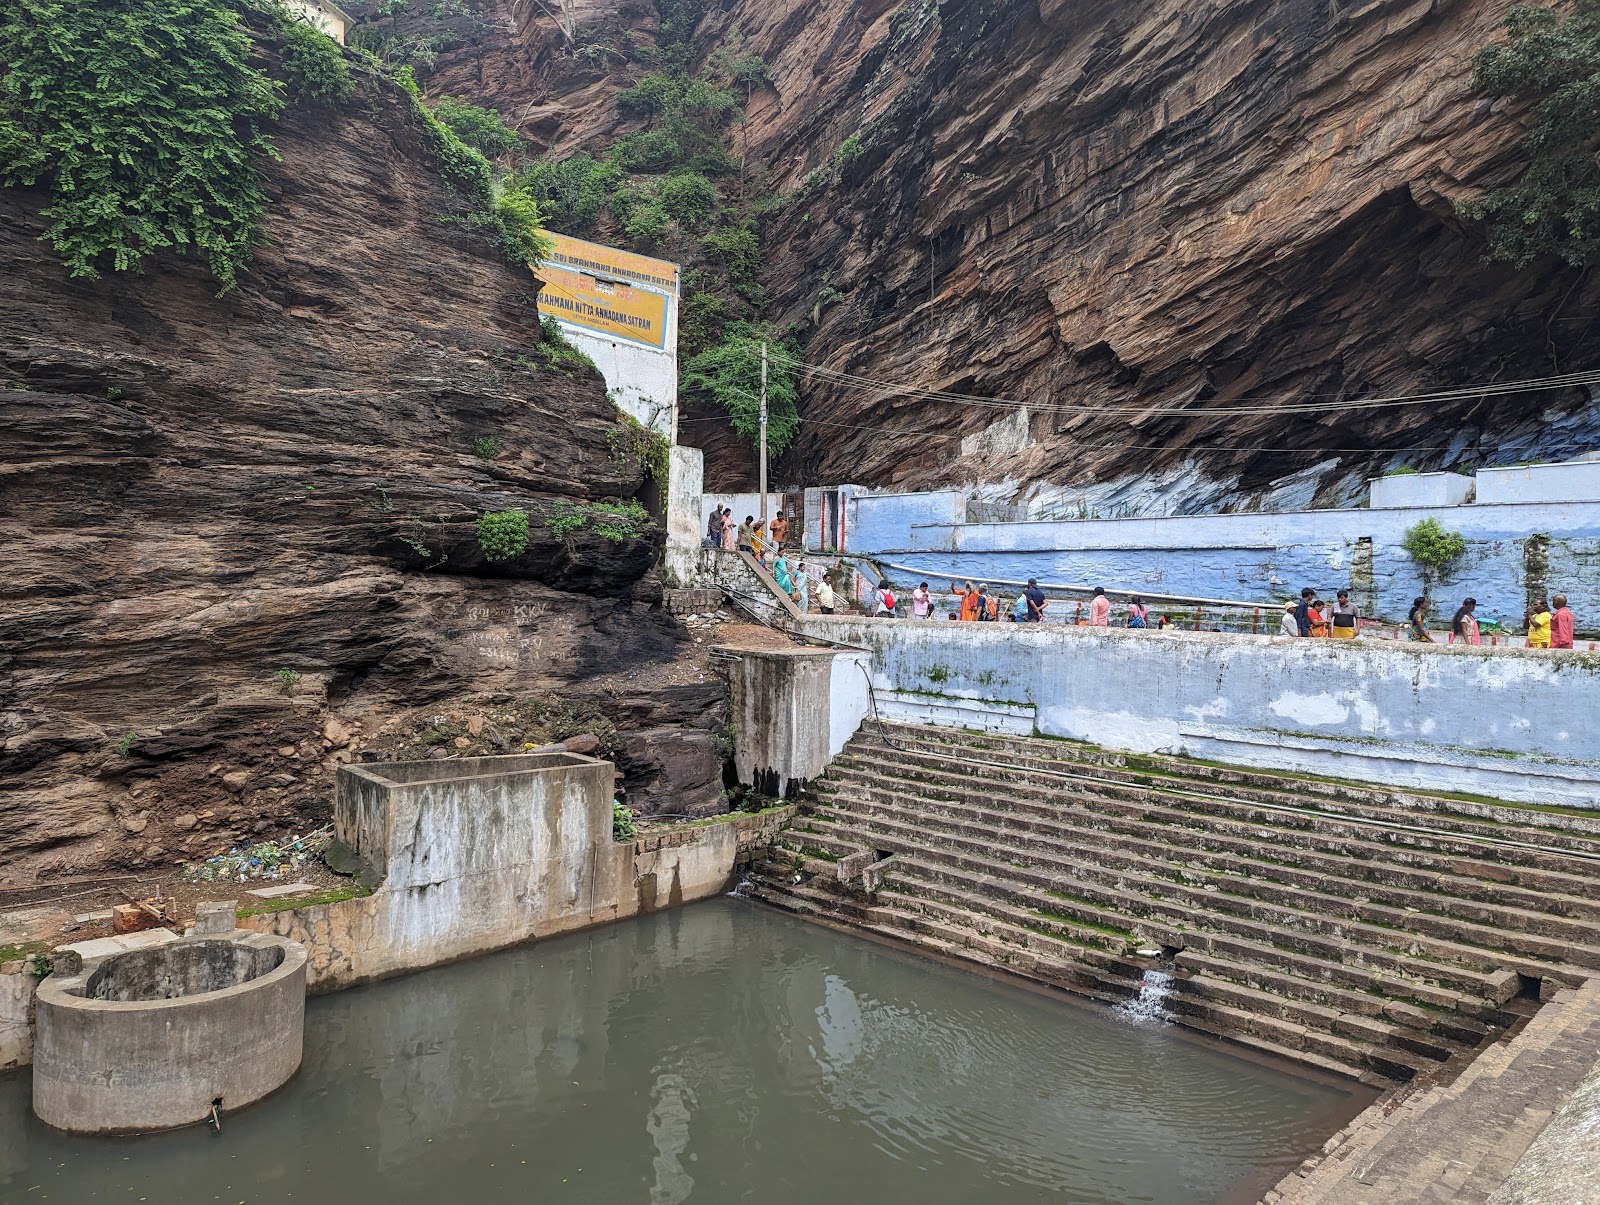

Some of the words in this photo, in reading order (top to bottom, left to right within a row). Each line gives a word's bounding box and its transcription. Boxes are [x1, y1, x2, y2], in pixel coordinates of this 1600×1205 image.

[569, 256, 611, 273] BRAHMANA
[612, 266, 651, 281] ANNADANA
[628, 314, 651, 330] SATRAM
